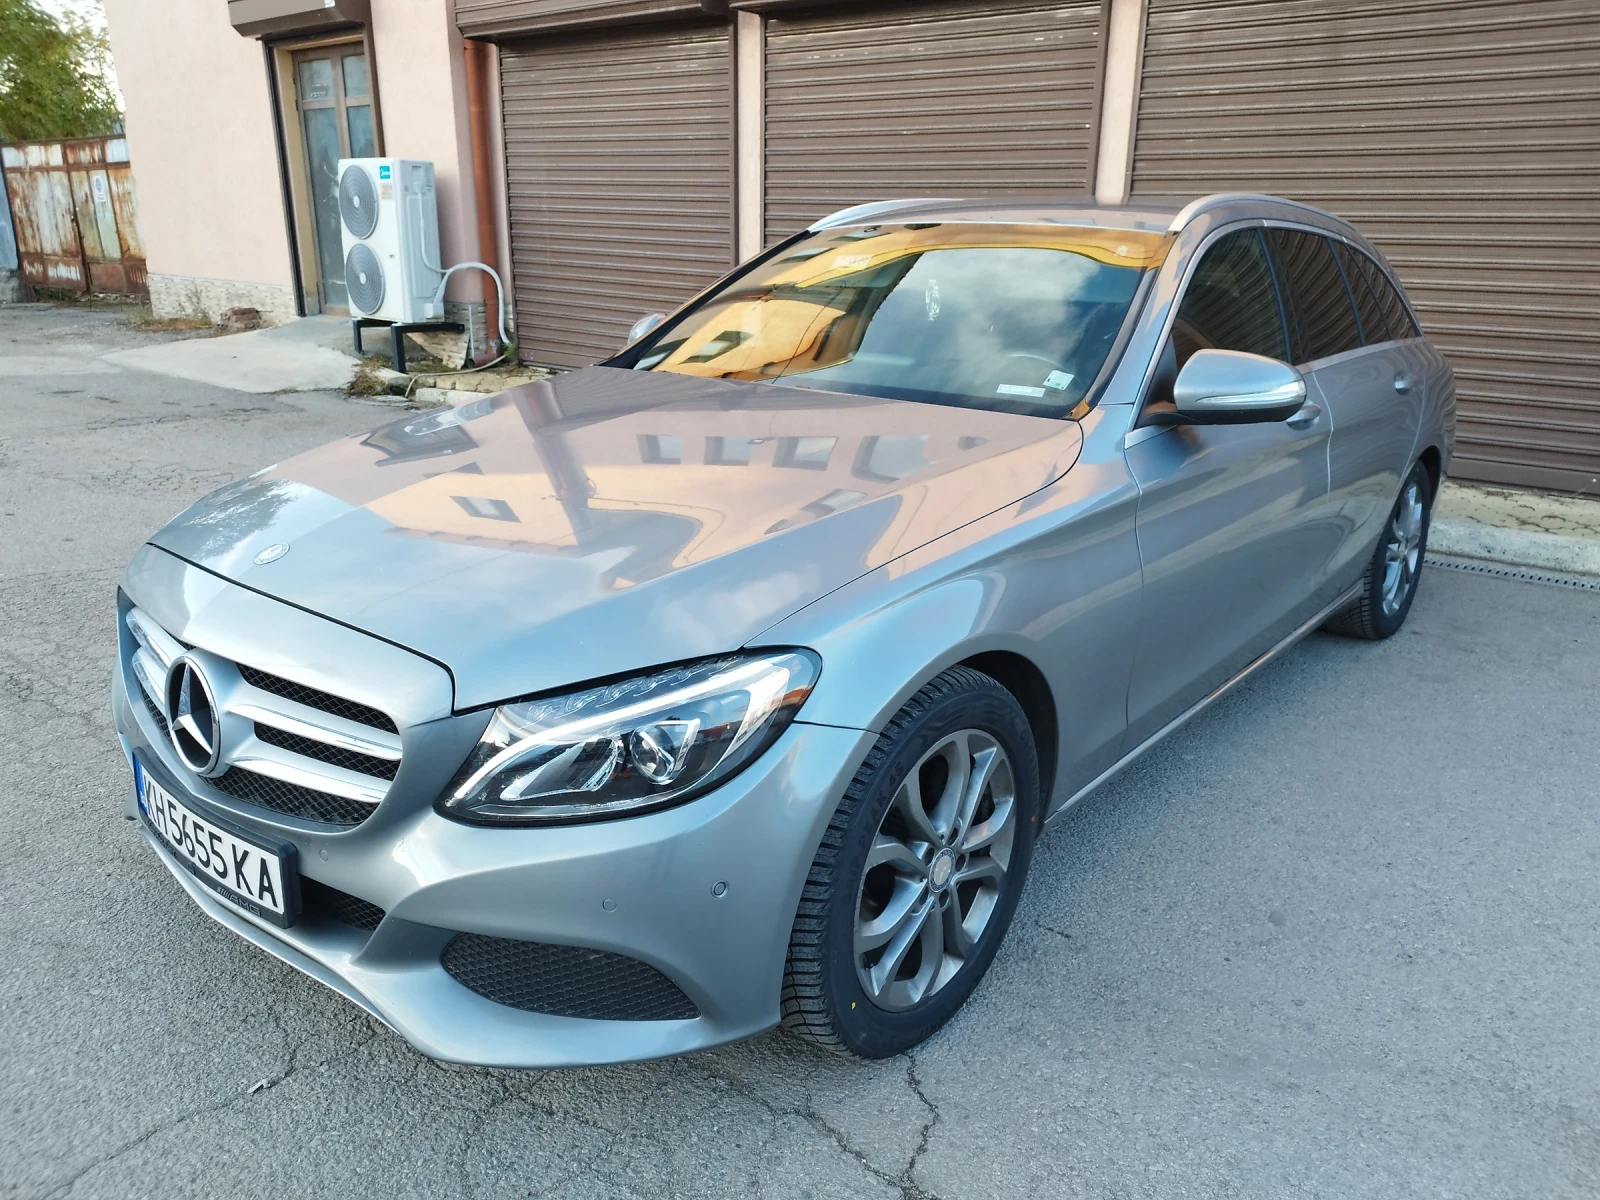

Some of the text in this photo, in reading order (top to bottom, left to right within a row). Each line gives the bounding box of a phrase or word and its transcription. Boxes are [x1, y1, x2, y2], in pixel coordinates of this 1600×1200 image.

[858, 789, 887, 847] PEAK
[889, 760, 904, 788] 4S
[228, 894, 261, 916] AMG
